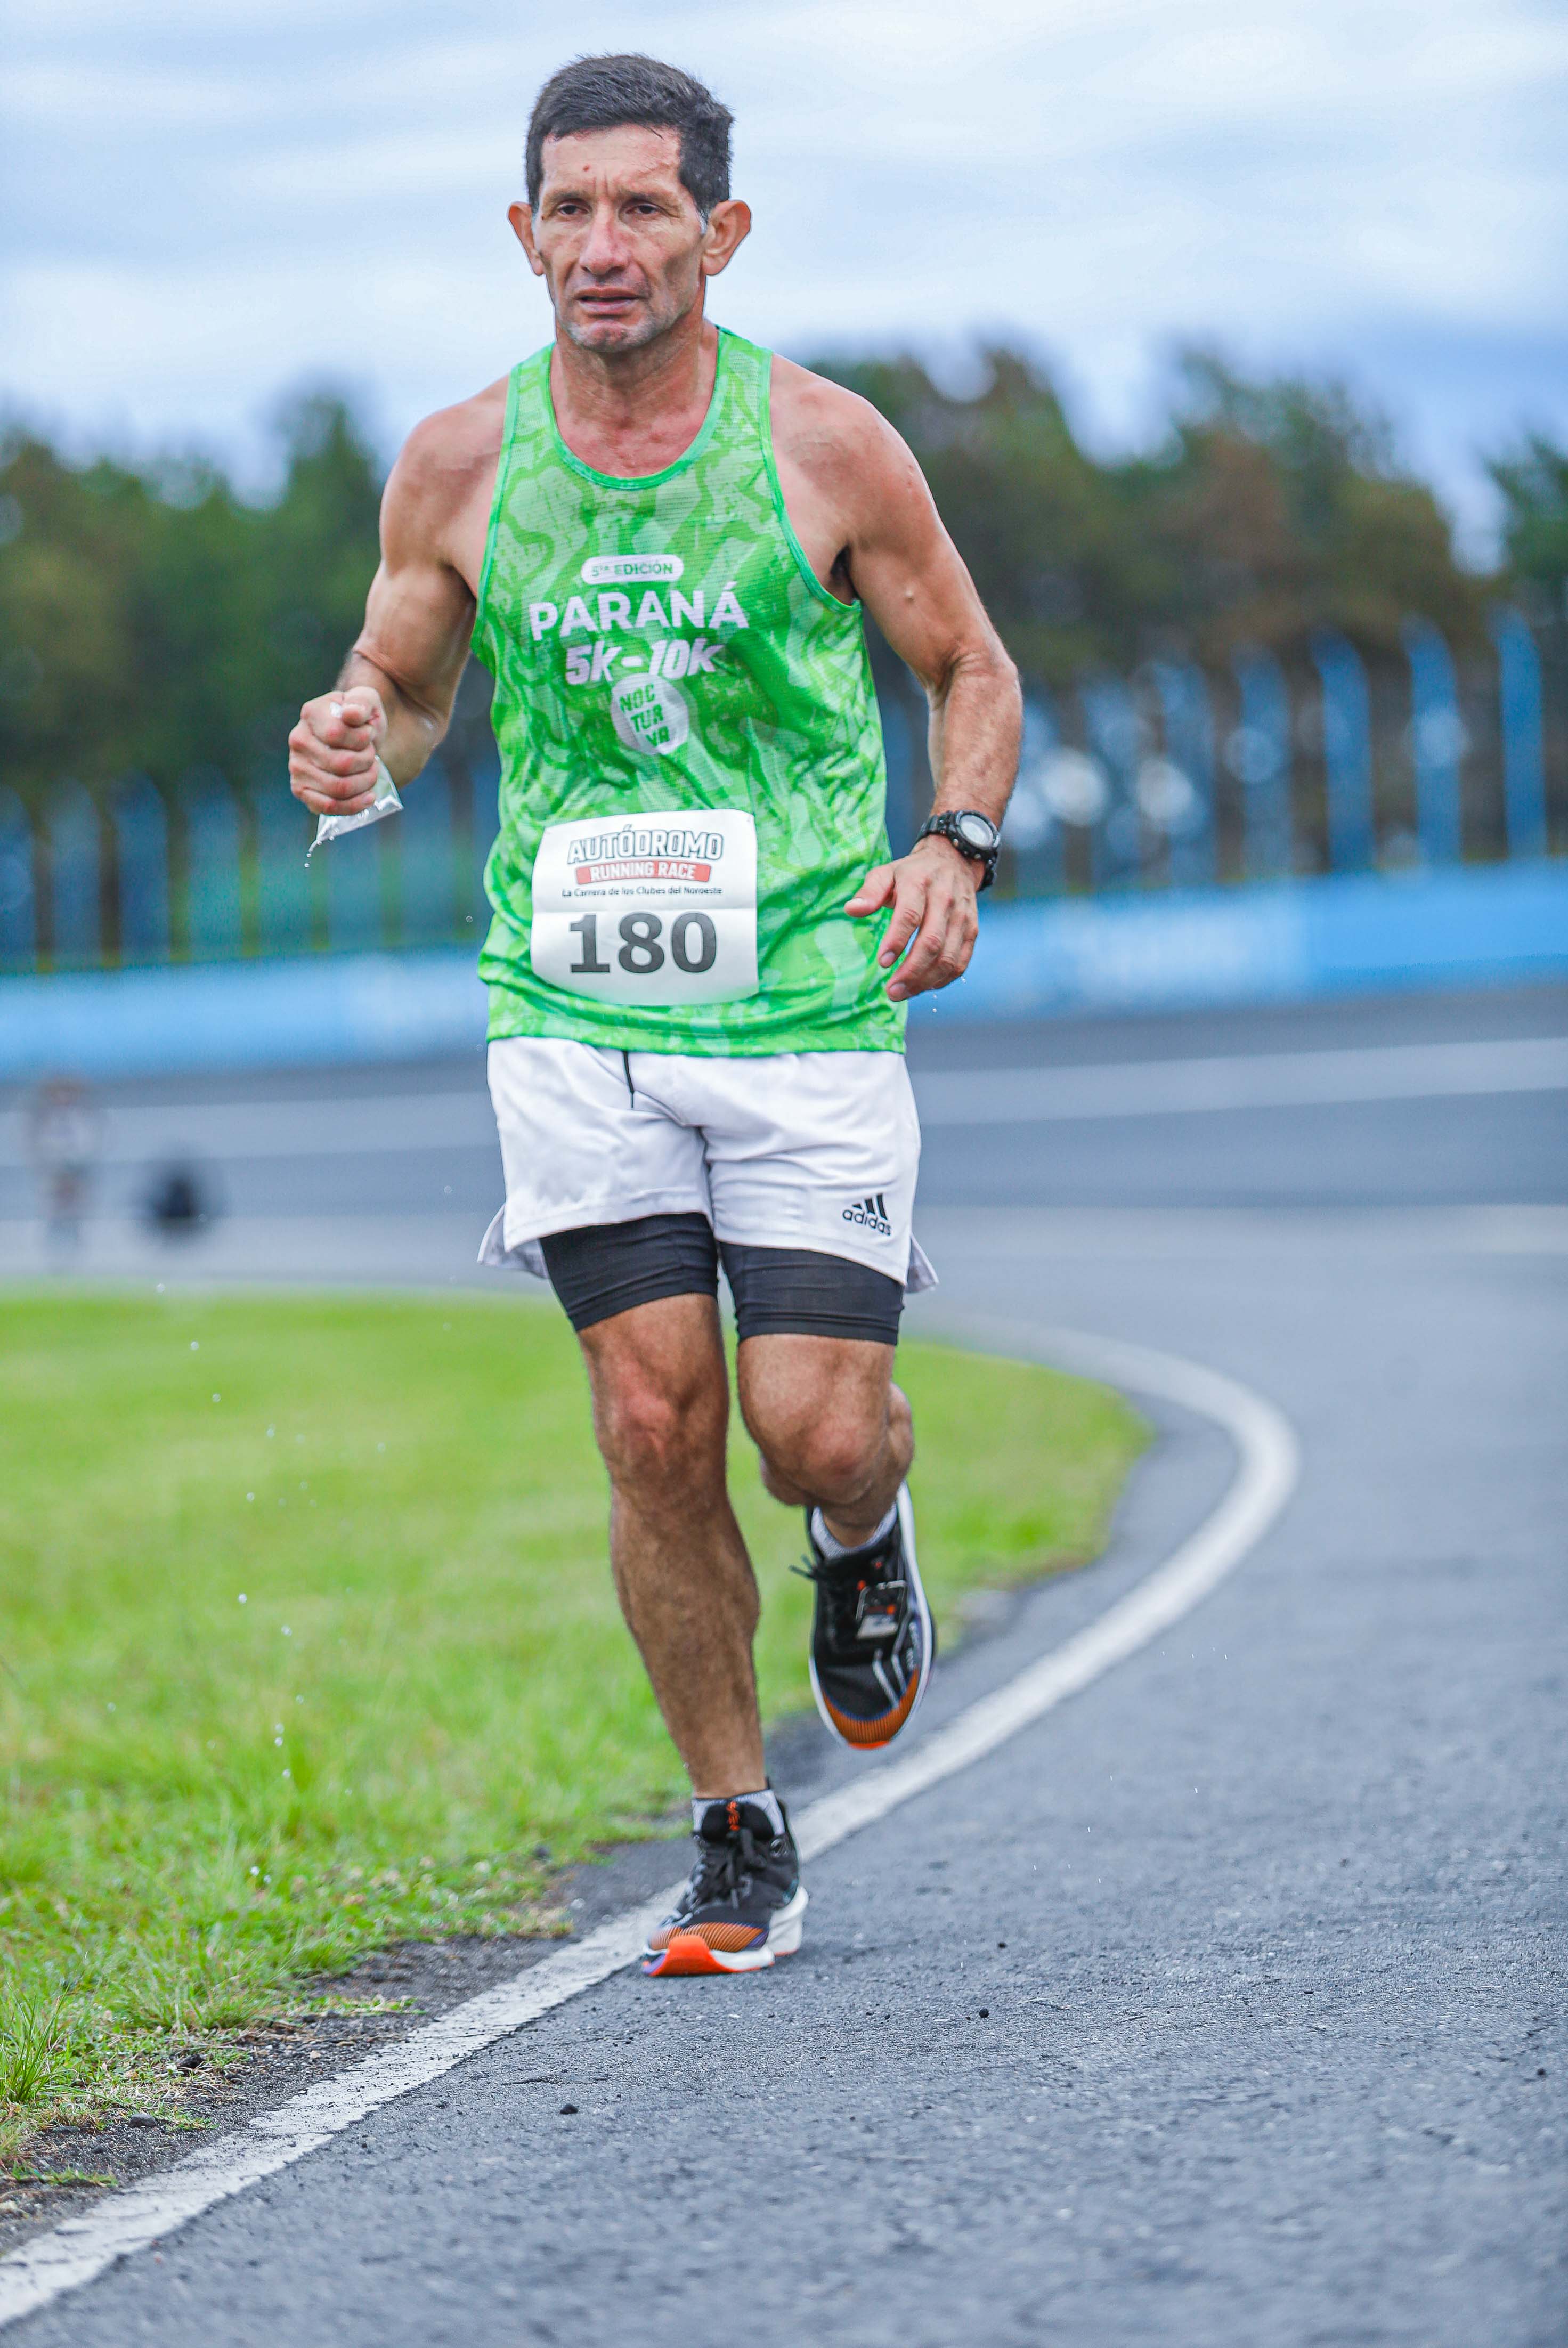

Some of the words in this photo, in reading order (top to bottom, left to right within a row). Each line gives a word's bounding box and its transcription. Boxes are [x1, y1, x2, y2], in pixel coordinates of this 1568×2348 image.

[614, 560, 673, 576] EDICIÓN
[529, 581, 749, 641] PARANÁ
[619, 683, 655, 713] NOC
[630, 704, 664, 733] TUR
[567, 824, 724, 864] AUTÓDROMO
[590, 860, 654, 881] RUNNING
[657, 860, 697, 879] RACE
[574, 887, 606, 896] Carrera
[608, 887, 619, 895] de
[621, 886, 635, 895] los
[636, 885, 665, 895] Clubes
[668, 885, 682, 894] del
[684, 886, 723, 895] Noroeste
[569, 912, 717, 974] 180
[842, 1209, 892, 1237] adidas
